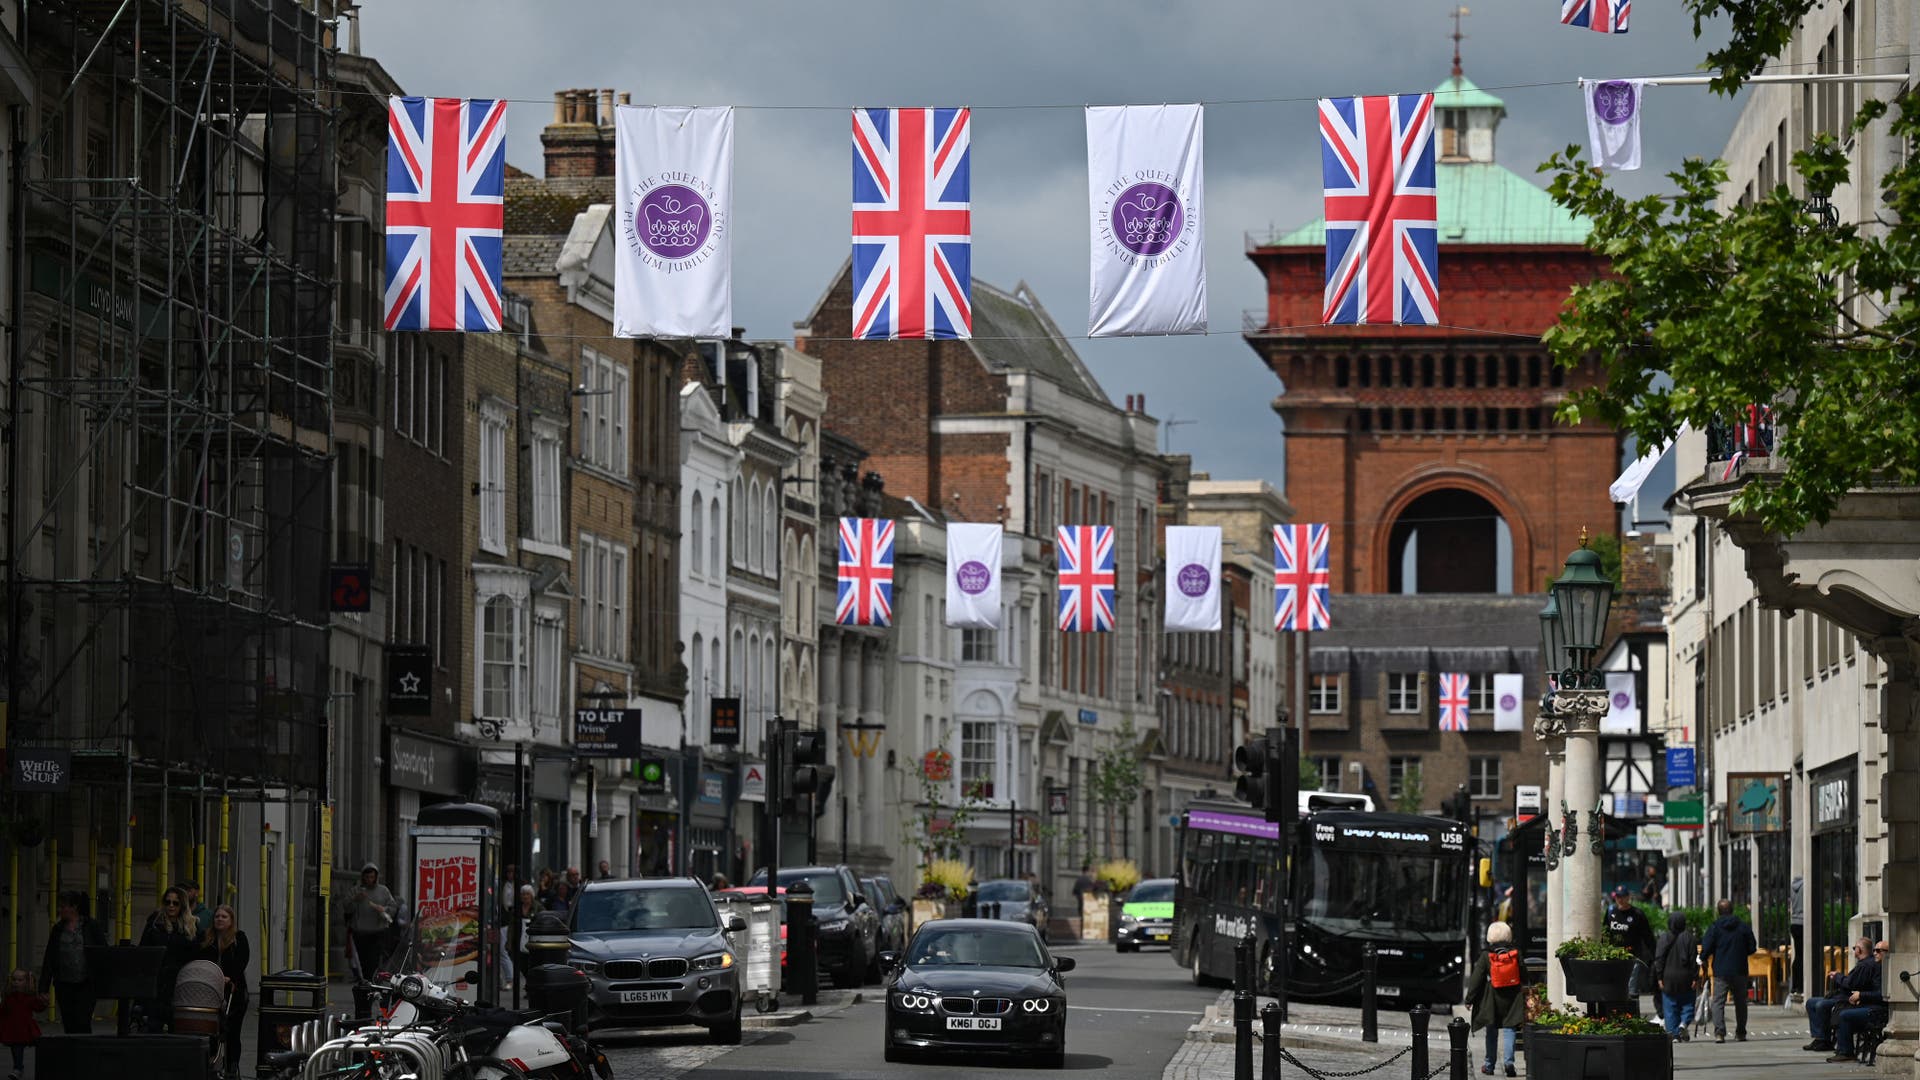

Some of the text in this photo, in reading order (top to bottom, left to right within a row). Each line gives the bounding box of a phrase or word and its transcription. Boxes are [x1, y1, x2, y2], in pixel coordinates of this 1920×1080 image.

[632, 171, 716, 199] THE QUEEN'S
[1107, 175, 1130, 197] THE
[624, 210, 725, 274] PLATINUM JUBILEE 2022
[1098, 207, 1197, 271] PLATINUM JUBILEE 2022
[578, 710, 624, 723] TO LET
[1316, 824, 1335, 833] Free
[1441, 833, 1463, 844] USB
[435, 856, 461, 867] PLAY
[418, 864, 477, 900] FIRE
[624, 991, 669, 1002] LG65 HYK
[950, 1018, 998, 1029] KM61 OGJ
